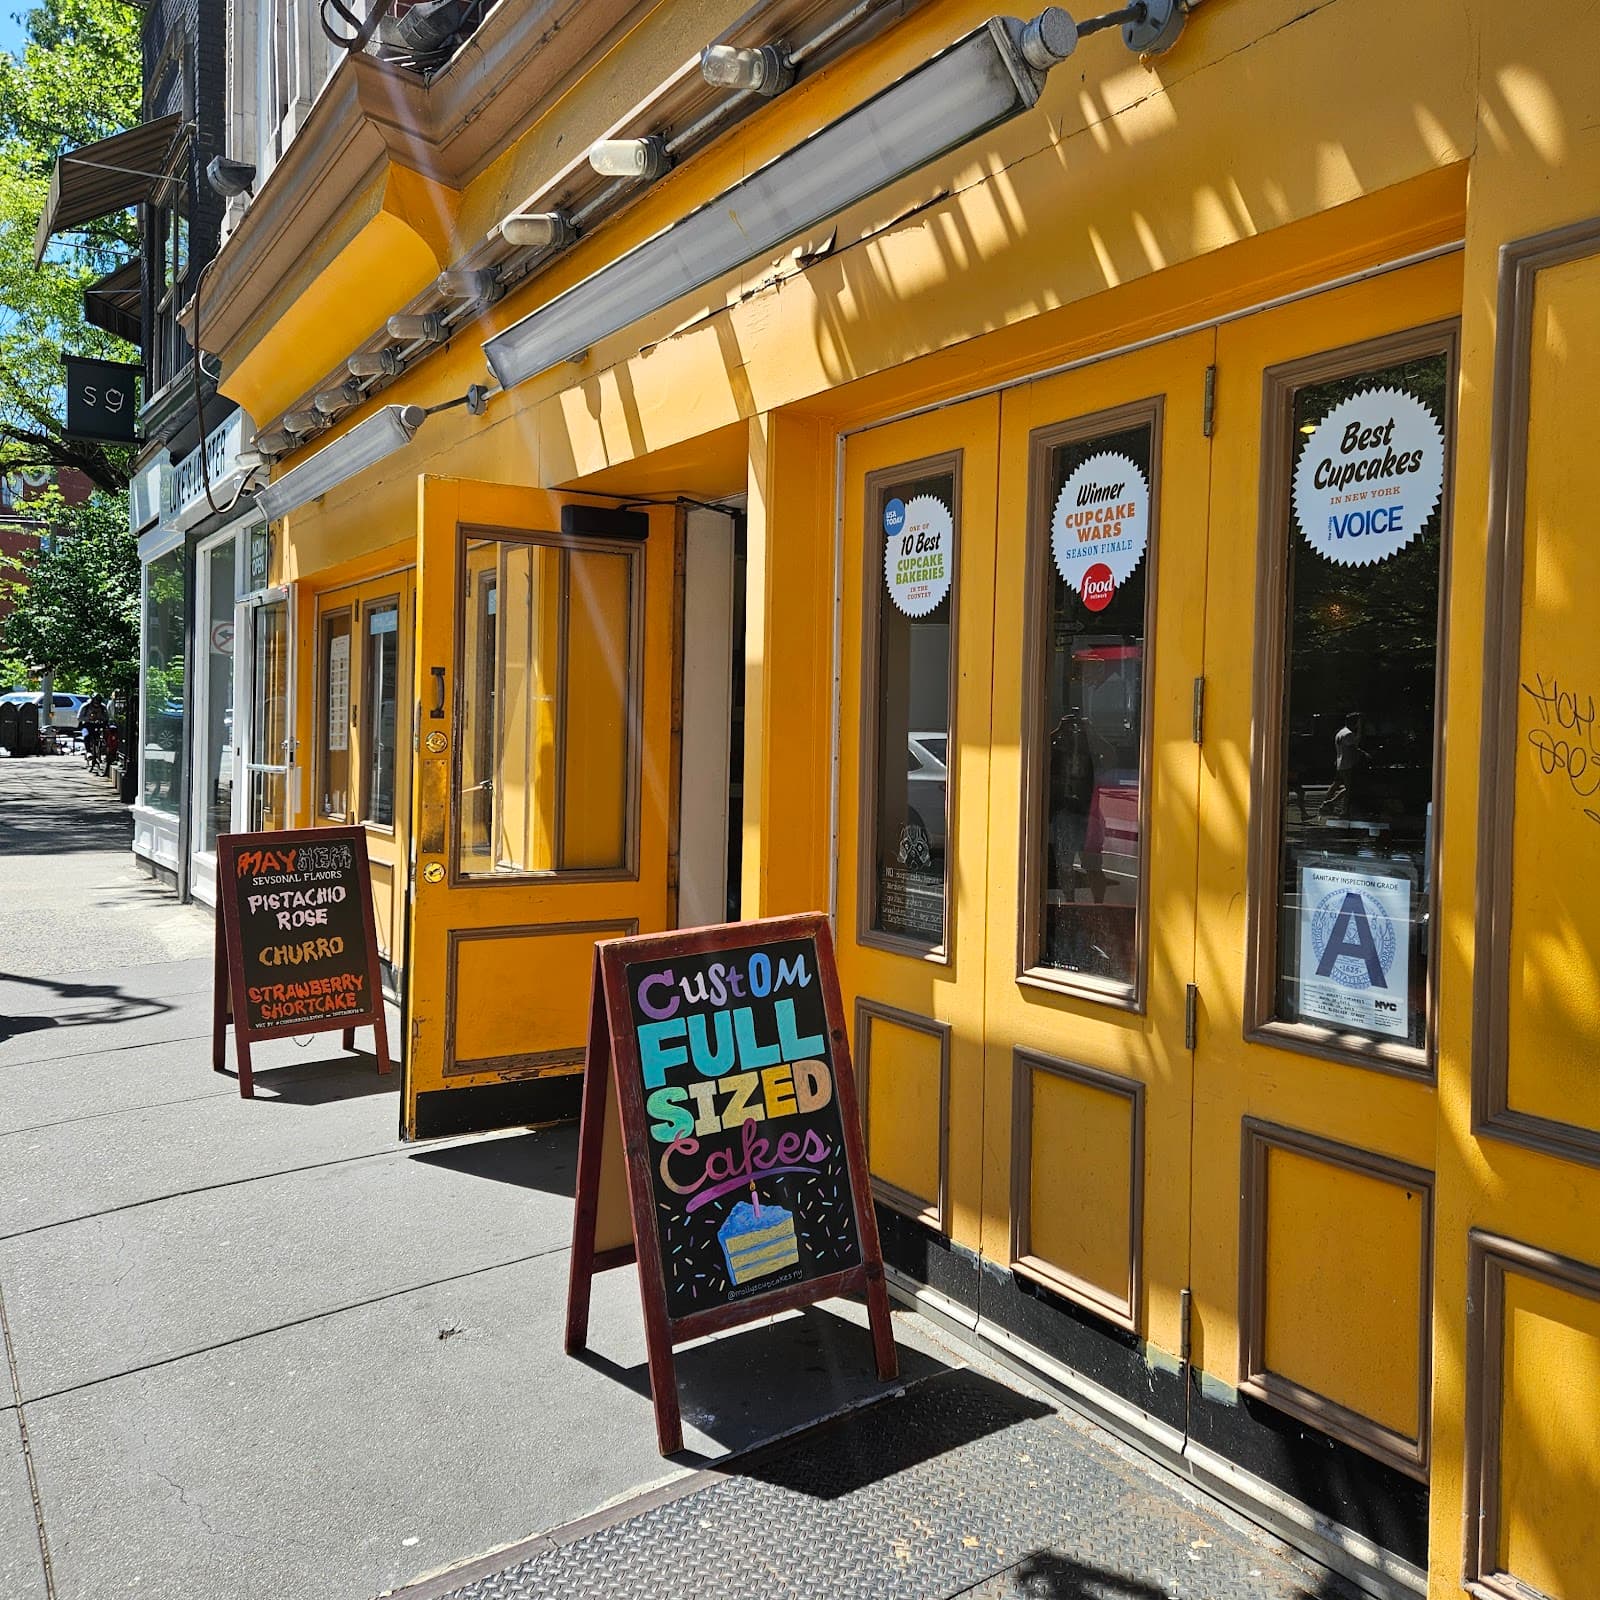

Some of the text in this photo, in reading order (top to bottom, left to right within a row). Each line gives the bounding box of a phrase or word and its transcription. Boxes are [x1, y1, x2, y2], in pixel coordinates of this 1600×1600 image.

[1340, 417, 1396, 454] Best
[193, 429, 226, 495] LOSTER
[1313, 445, 1424, 492] Cupcakes
[1076, 482, 1125, 507] Winner
[1330, 486, 1401, 505] IN NEW YORK
[886, 510, 897, 519] USA
[886, 515, 903, 526] TODAY
[1065, 502, 1136, 529] CUPCAKE
[1332, 505, 1404, 540] VOICE
[901, 531, 941, 556] 10 Best
[1077, 522, 1122, 543] WARS
[897, 553, 943, 572] CUPCAKE
[1066, 539, 1133, 560] SEASON FINALE
[895, 566, 945, 585] BAKERIES
[1082, 574, 1114, 602] food
[907, 591, 931, 600] COUNTRY
[303, 870, 342, 882] FLAVORS
[1312, 873, 1399, 891] SANITARY INSPECTION GRADE
[248, 885, 346, 915] PISTACHIO
[276, 908, 328, 930] ROSE
[258, 936, 344, 966] CHURRO
[1315, 892, 1388, 989] A
[248, 973, 364, 1003] STRAWBERRY
[261, 992, 356, 1019] SHORTCAKE
[637, 998, 826, 1090] FULL
[646, 1059, 833, 1144] SIZED
[659, 1117, 832, 1196] Cakes
